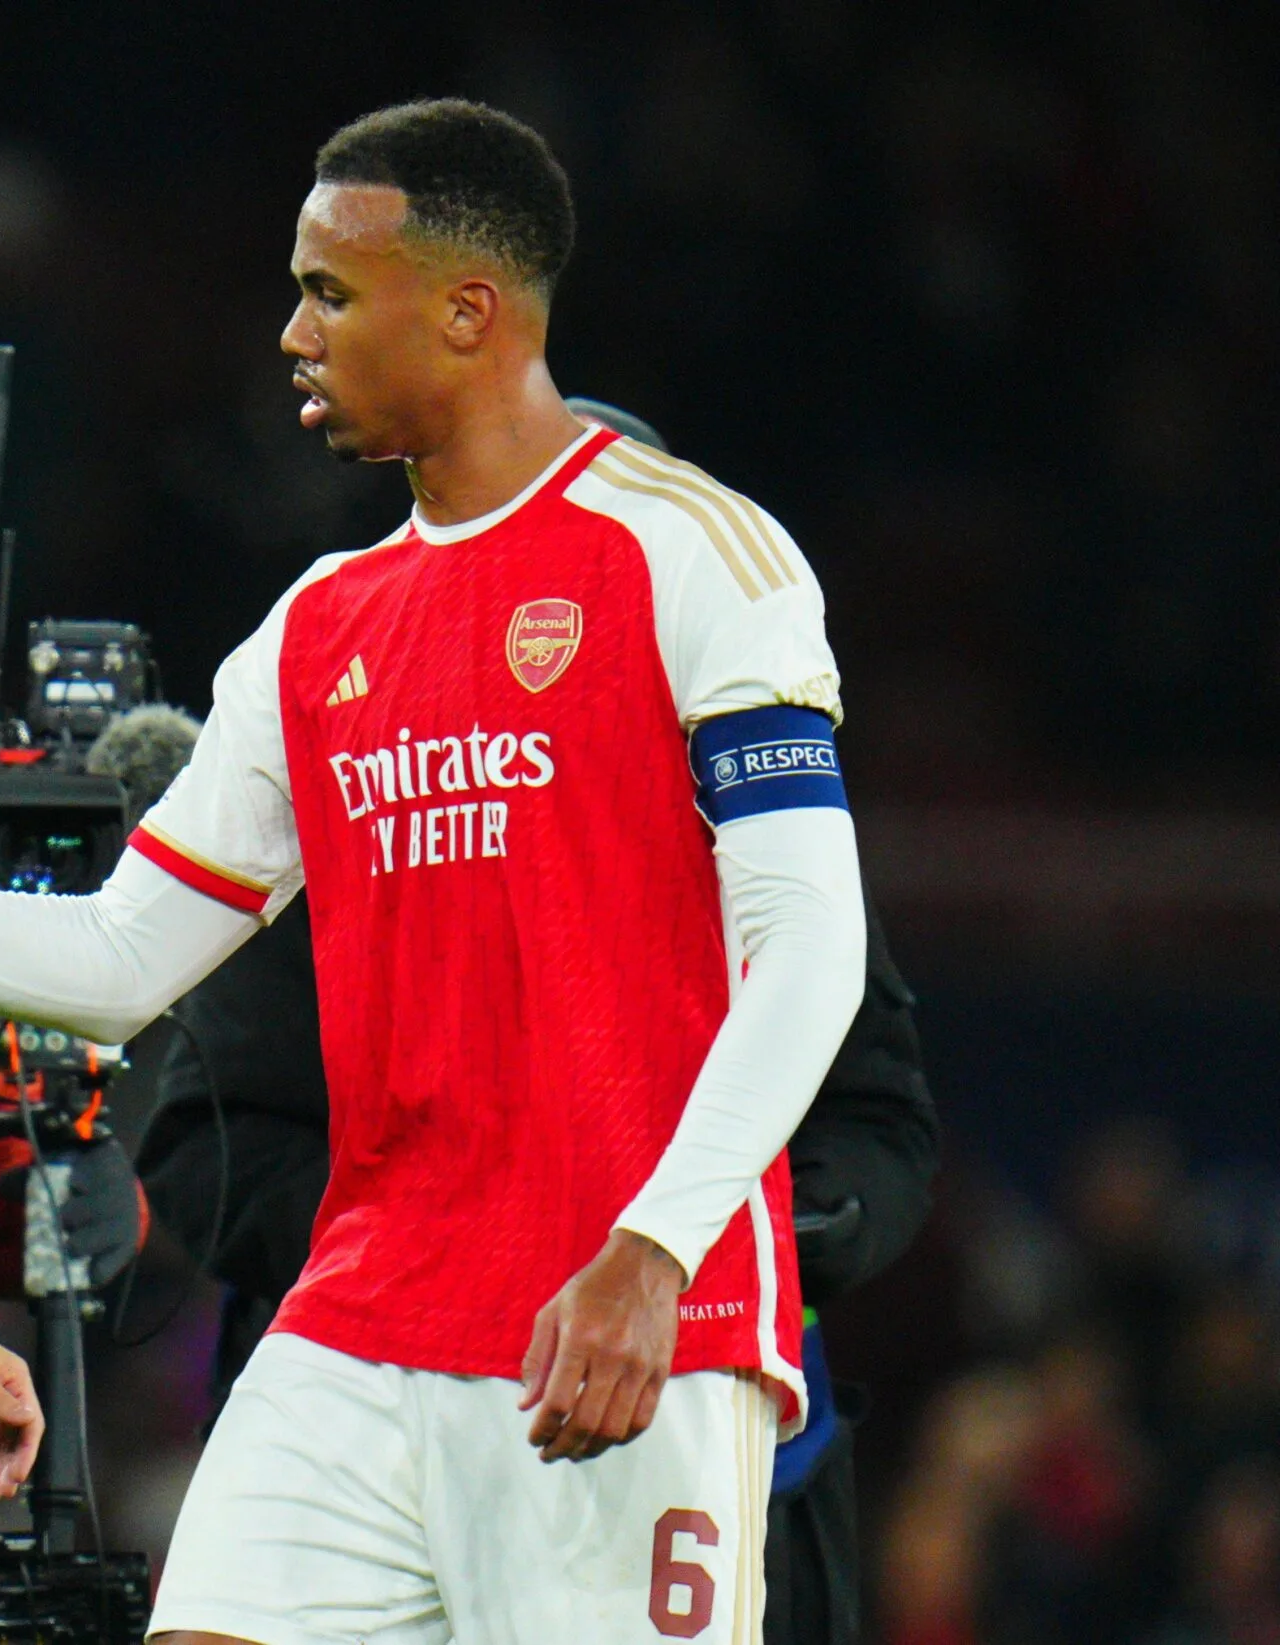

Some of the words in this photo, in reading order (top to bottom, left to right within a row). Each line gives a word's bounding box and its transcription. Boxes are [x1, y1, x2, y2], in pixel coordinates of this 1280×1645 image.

[520, 615, 570, 630] Arsenal
[329, 721, 555, 822] Emirates
[744, 746, 835, 773] RESPECT
[679, 1301, 745, 1321] HEAT.RDY
[648, 1507, 719, 1639] 6
